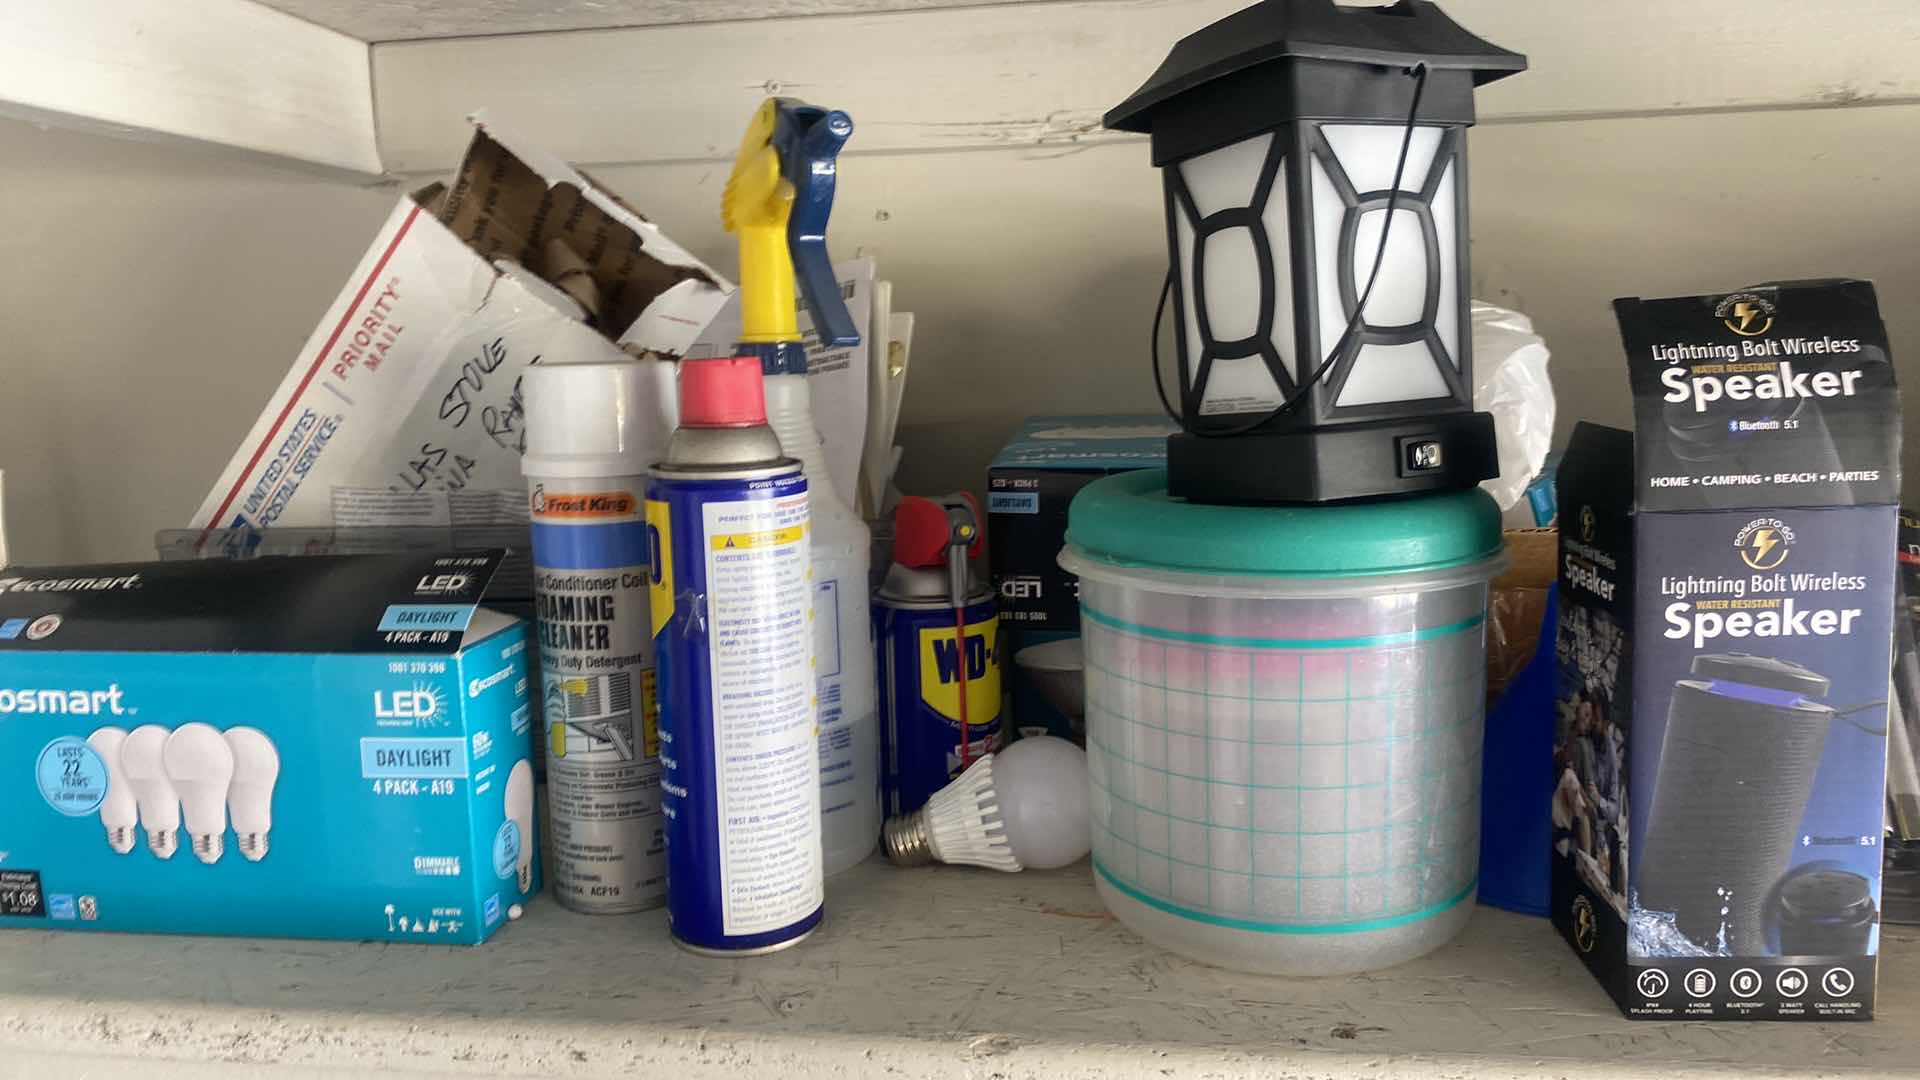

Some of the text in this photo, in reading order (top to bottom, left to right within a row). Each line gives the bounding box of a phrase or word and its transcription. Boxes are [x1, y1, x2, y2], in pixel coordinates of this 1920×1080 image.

[331, 279, 401, 382] PRIORITY
[363, 325, 405, 372] MAIL
[1651, 336, 1861, 365] Lightning Bolt Wireless
[1661, 361, 1863, 412] Speaker
[1739, 420, 1799, 431] Bluetooth 5.1
[243, 406, 319, 515] UNITED STATES
[259, 415, 338, 529] POSTAL SERVICE
[1651, 470, 1880, 488] HOME CAMPING BEACH PARTIES
[549, 497, 628, 512] Frost King
[10, 573, 140, 592] ecosmart
[416, 574, 467, 591] LED
[546, 572, 617, 592] Conditioner
[1565, 553, 1615, 602] Speaker
[1661, 571, 1866, 599] Lightning Bolt Wireless
[1001, 580, 1042, 598] LED
[396, 611, 458, 624] DAYLIGHT
[1663, 598, 1862, 649] Speaker
[385, 632, 393, 644] 4
[394, 631, 421, 643] PACK
[429, 631, 449, 643] A19
[561, 654, 583, 670] Duty
[585, 652, 642, 670] Detergent
[373, 690, 437, 718] LED
[57, 747, 85, 759] LASTS
[376, 749, 453, 767] DAYLIGHT
[63, 759, 82, 777] 22
[61, 776, 90, 788] YEARS
[373, 779, 382, 795] 4
[384, 779, 419, 795] PACK
[431, 779, 455, 795] A19
[1860, 835, 1876, 846] 5.1
